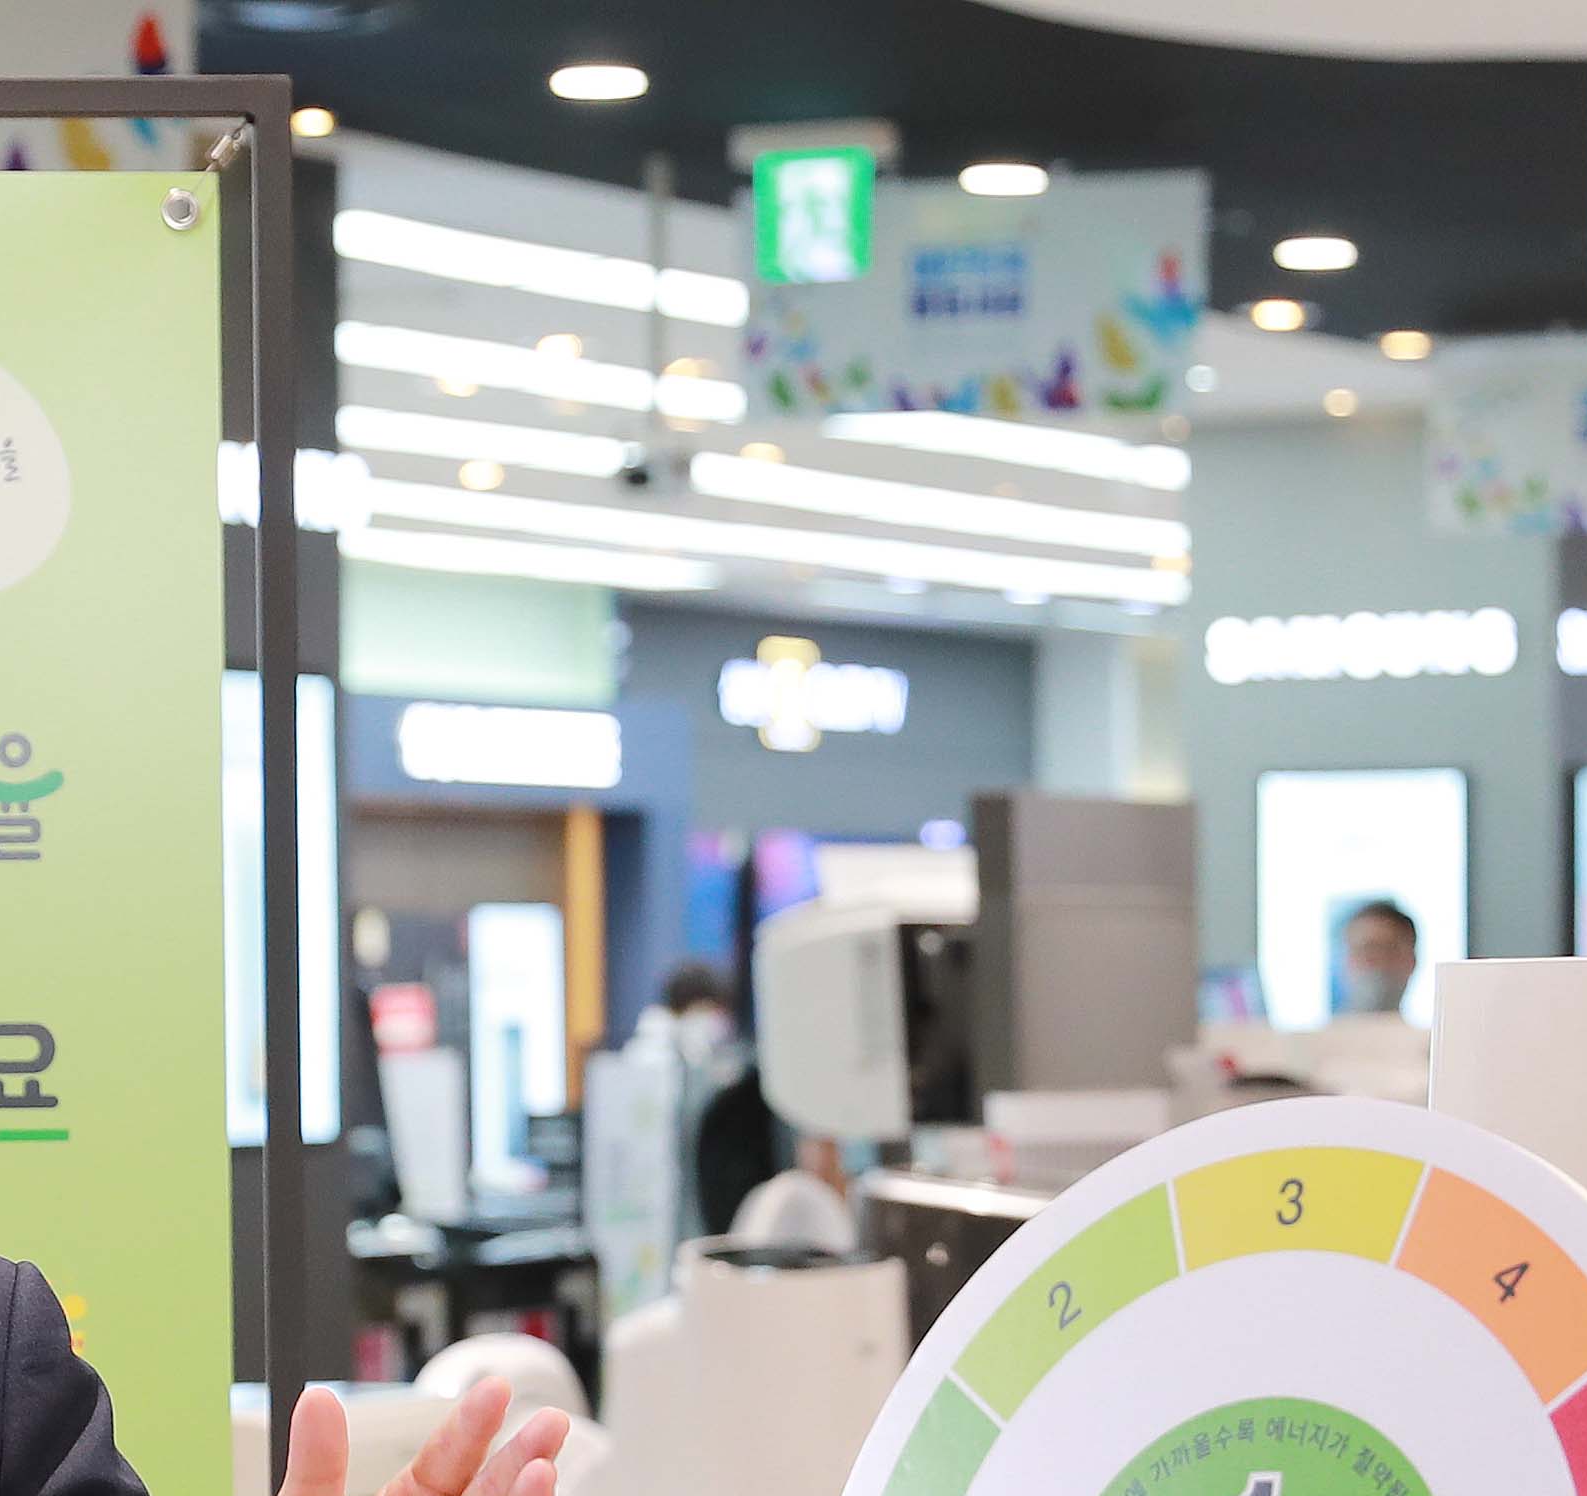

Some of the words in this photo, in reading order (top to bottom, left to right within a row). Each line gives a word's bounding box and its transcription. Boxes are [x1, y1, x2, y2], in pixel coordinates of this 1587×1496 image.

[1276, 1178, 1306, 1226] 3
[1047, 1280, 1083, 1330] 2
[1491, 1260, 1530, 1304] 4
[1148, 1416, 1256, 1483] 가까울수록
[1265, 1415, 1351, 1460] 에너지가
